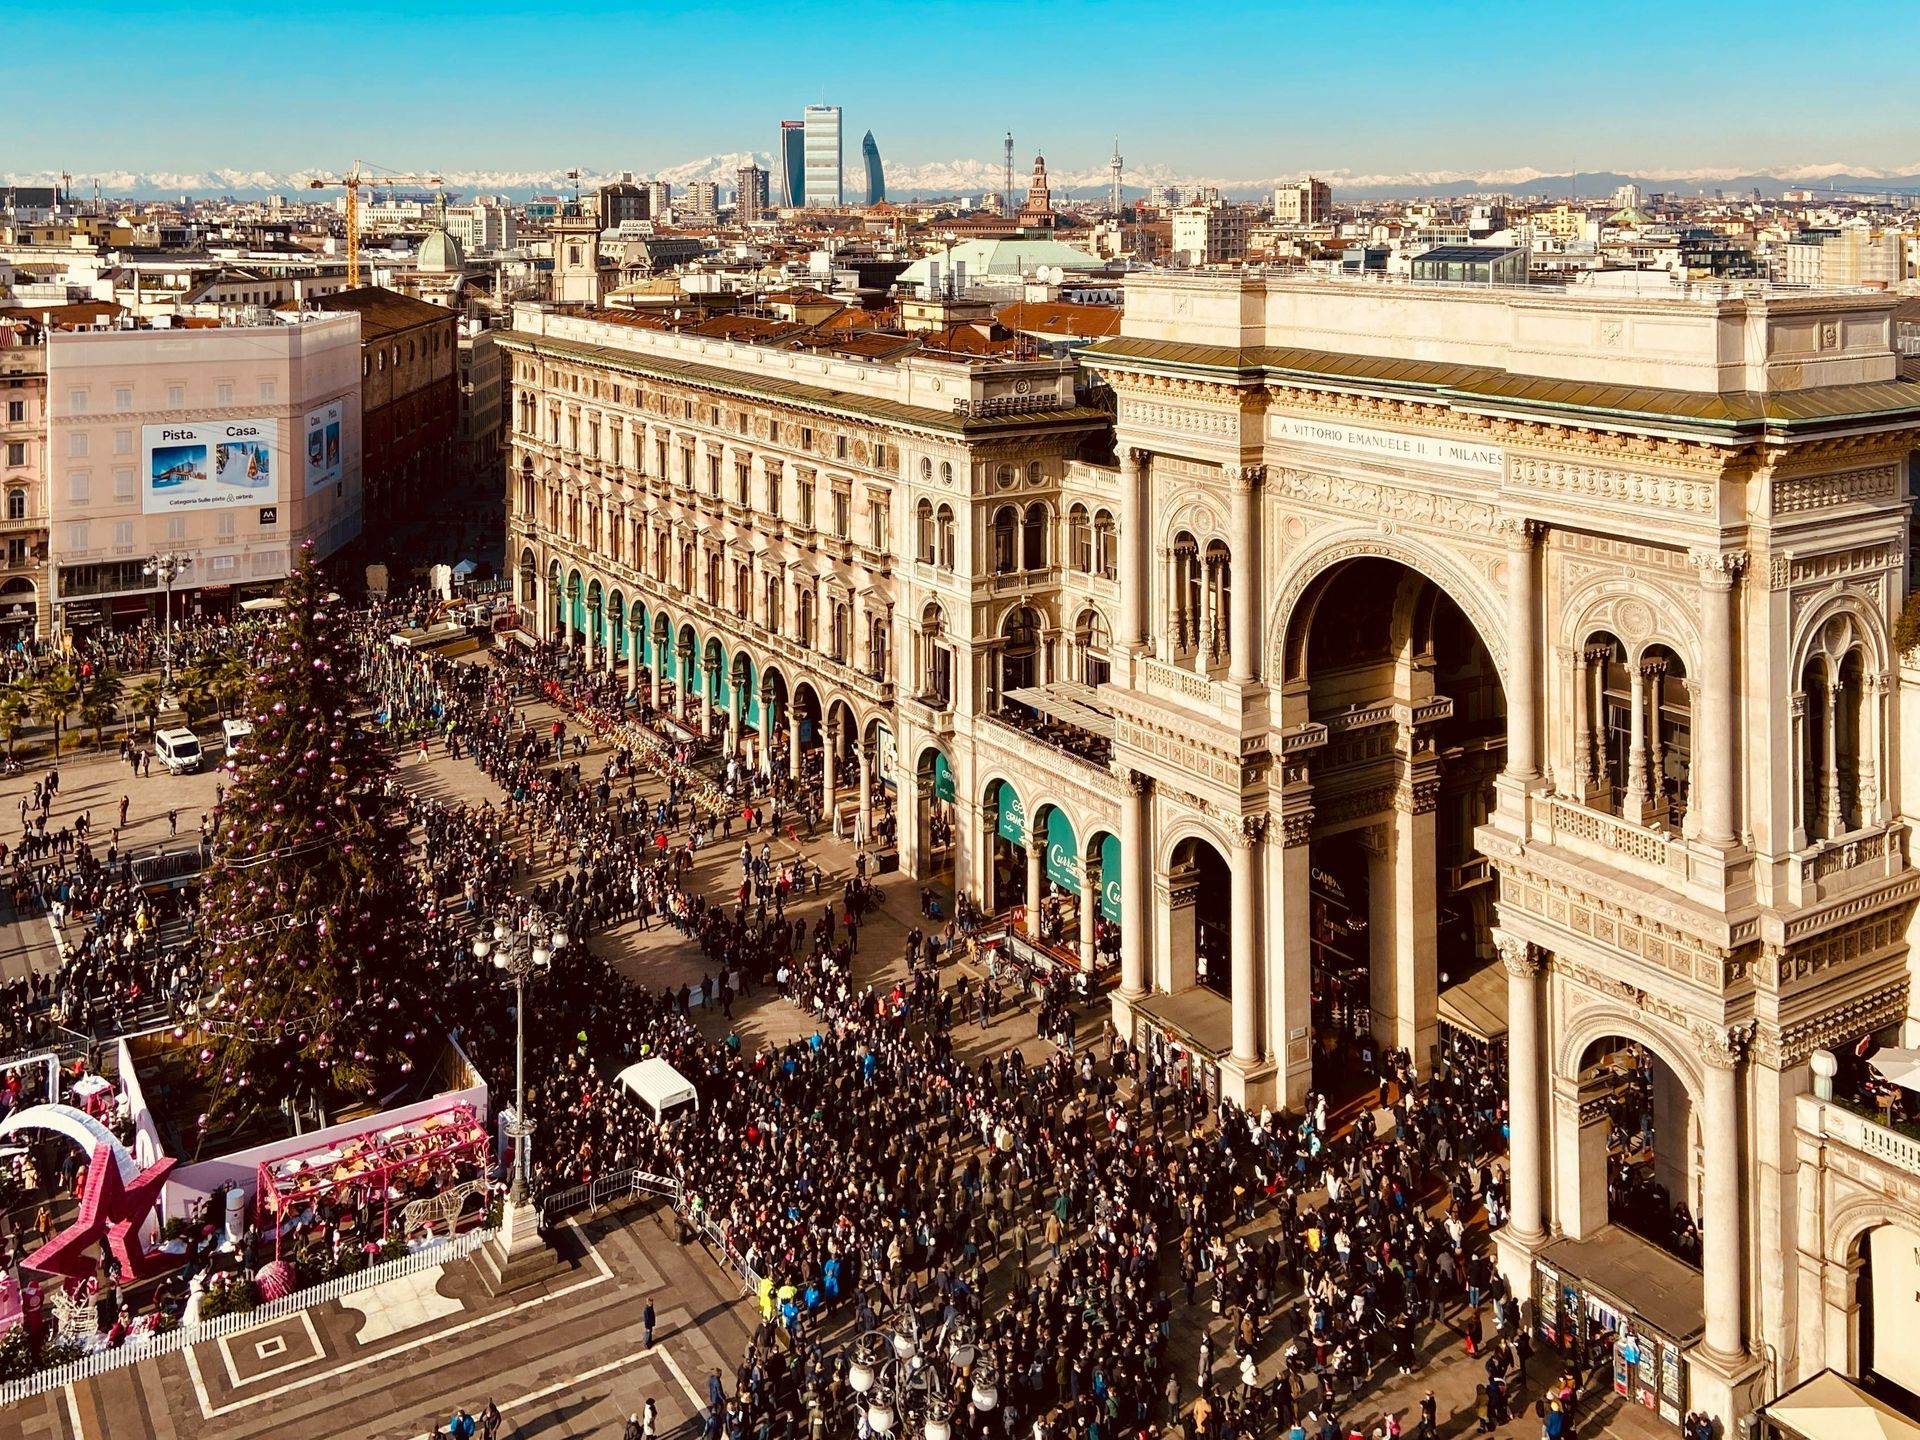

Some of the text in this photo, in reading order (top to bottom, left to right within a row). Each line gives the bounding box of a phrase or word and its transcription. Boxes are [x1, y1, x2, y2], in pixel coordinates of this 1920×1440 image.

[162, 430, 197, 440] Pista.
[226, 426, 260, 436] Casa.
[1294, 424, 1342, 442] VITTORIO
[1348, 432, 1412, 452] EMANUELE
[1013, 910, 1023, 920] M
